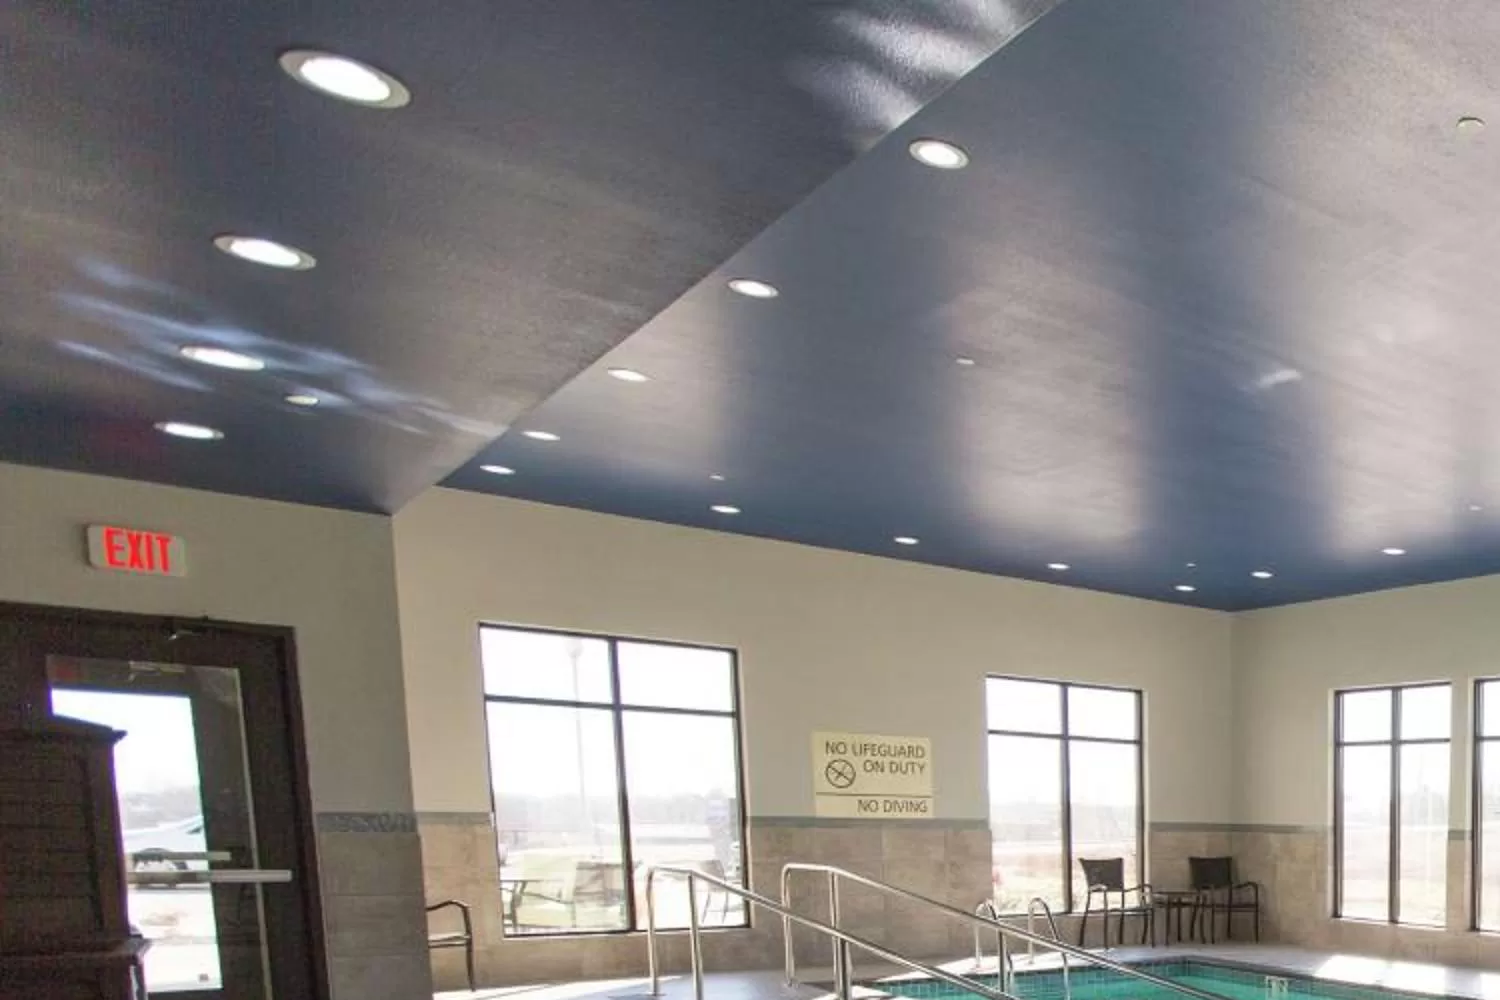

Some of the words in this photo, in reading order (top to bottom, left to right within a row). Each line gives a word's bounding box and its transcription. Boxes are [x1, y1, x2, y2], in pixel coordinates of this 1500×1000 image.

[104, 527, 172, 574] EXIT
[825, 741, 848, 756] NO
[852, 743, 926, 759] LIFEGUARD
[863, 760, 885, 773] ON
[889, 761, 926, 775] DUTY
[857, 799, 879, 812] NO
[883, 800, 929, 813] DIVING
